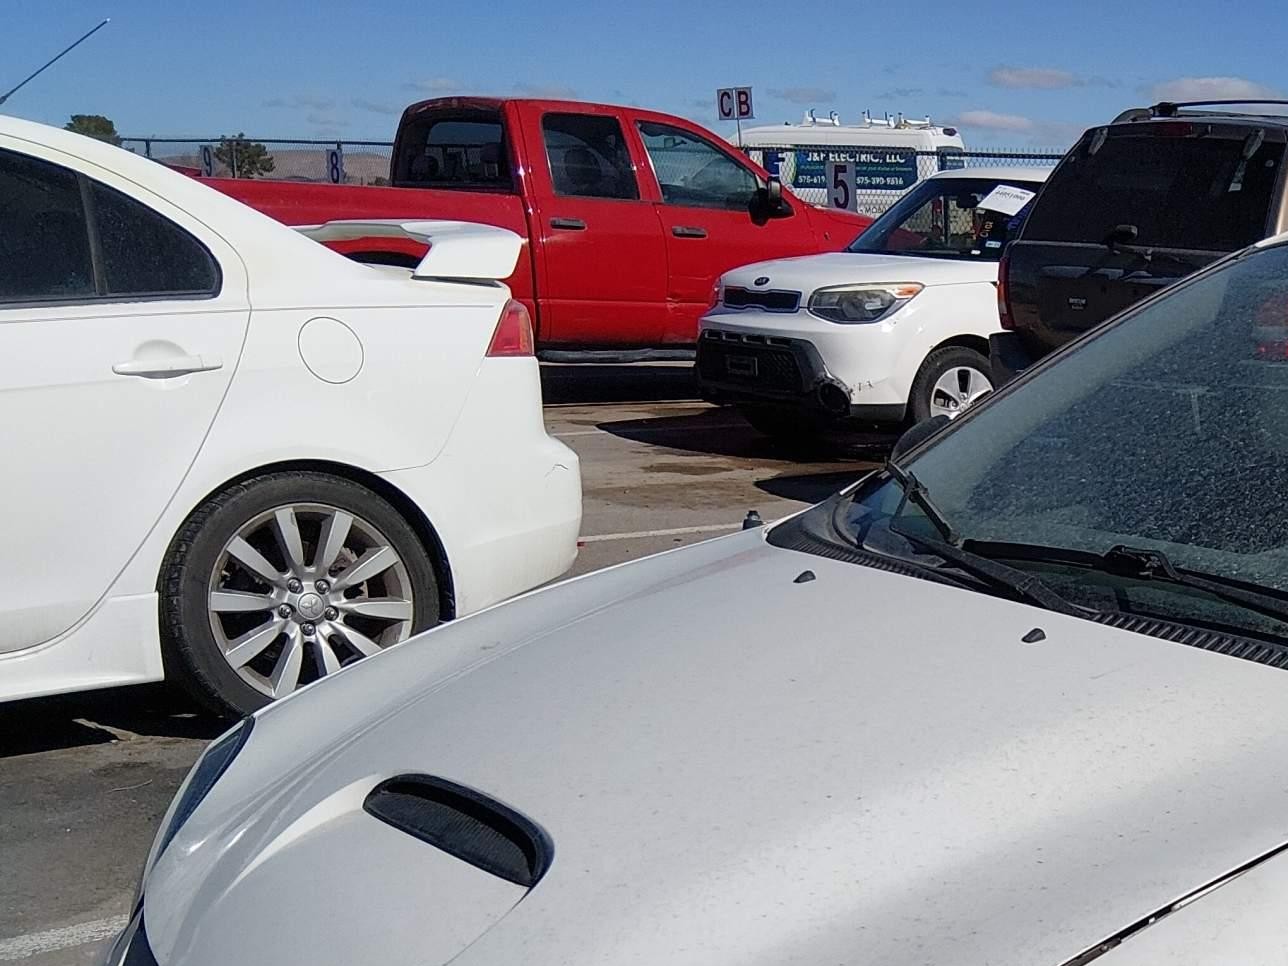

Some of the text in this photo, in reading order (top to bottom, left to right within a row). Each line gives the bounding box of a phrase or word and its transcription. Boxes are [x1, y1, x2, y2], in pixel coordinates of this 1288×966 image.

[203, 146, 213, 177] 9
[330, 151, 340, 183] 8
[886, 153, 906, 164] LLC
[833, 164, 850, 209] 5
